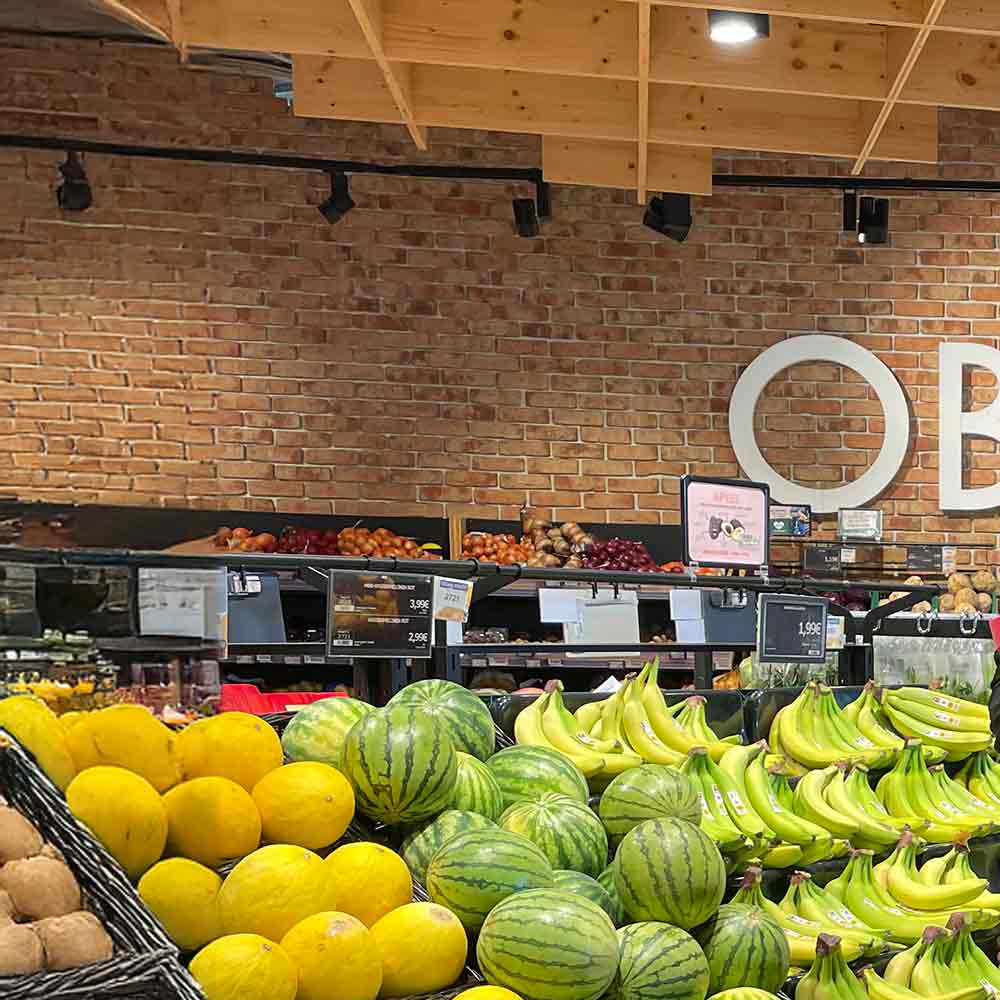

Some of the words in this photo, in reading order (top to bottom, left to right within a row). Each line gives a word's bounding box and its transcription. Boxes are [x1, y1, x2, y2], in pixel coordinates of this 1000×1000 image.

[409, 599, 430, 610] 3,99€
[798, 621, 822, 638] 1,99€
[408, 632, 428, 643] 2,99€
